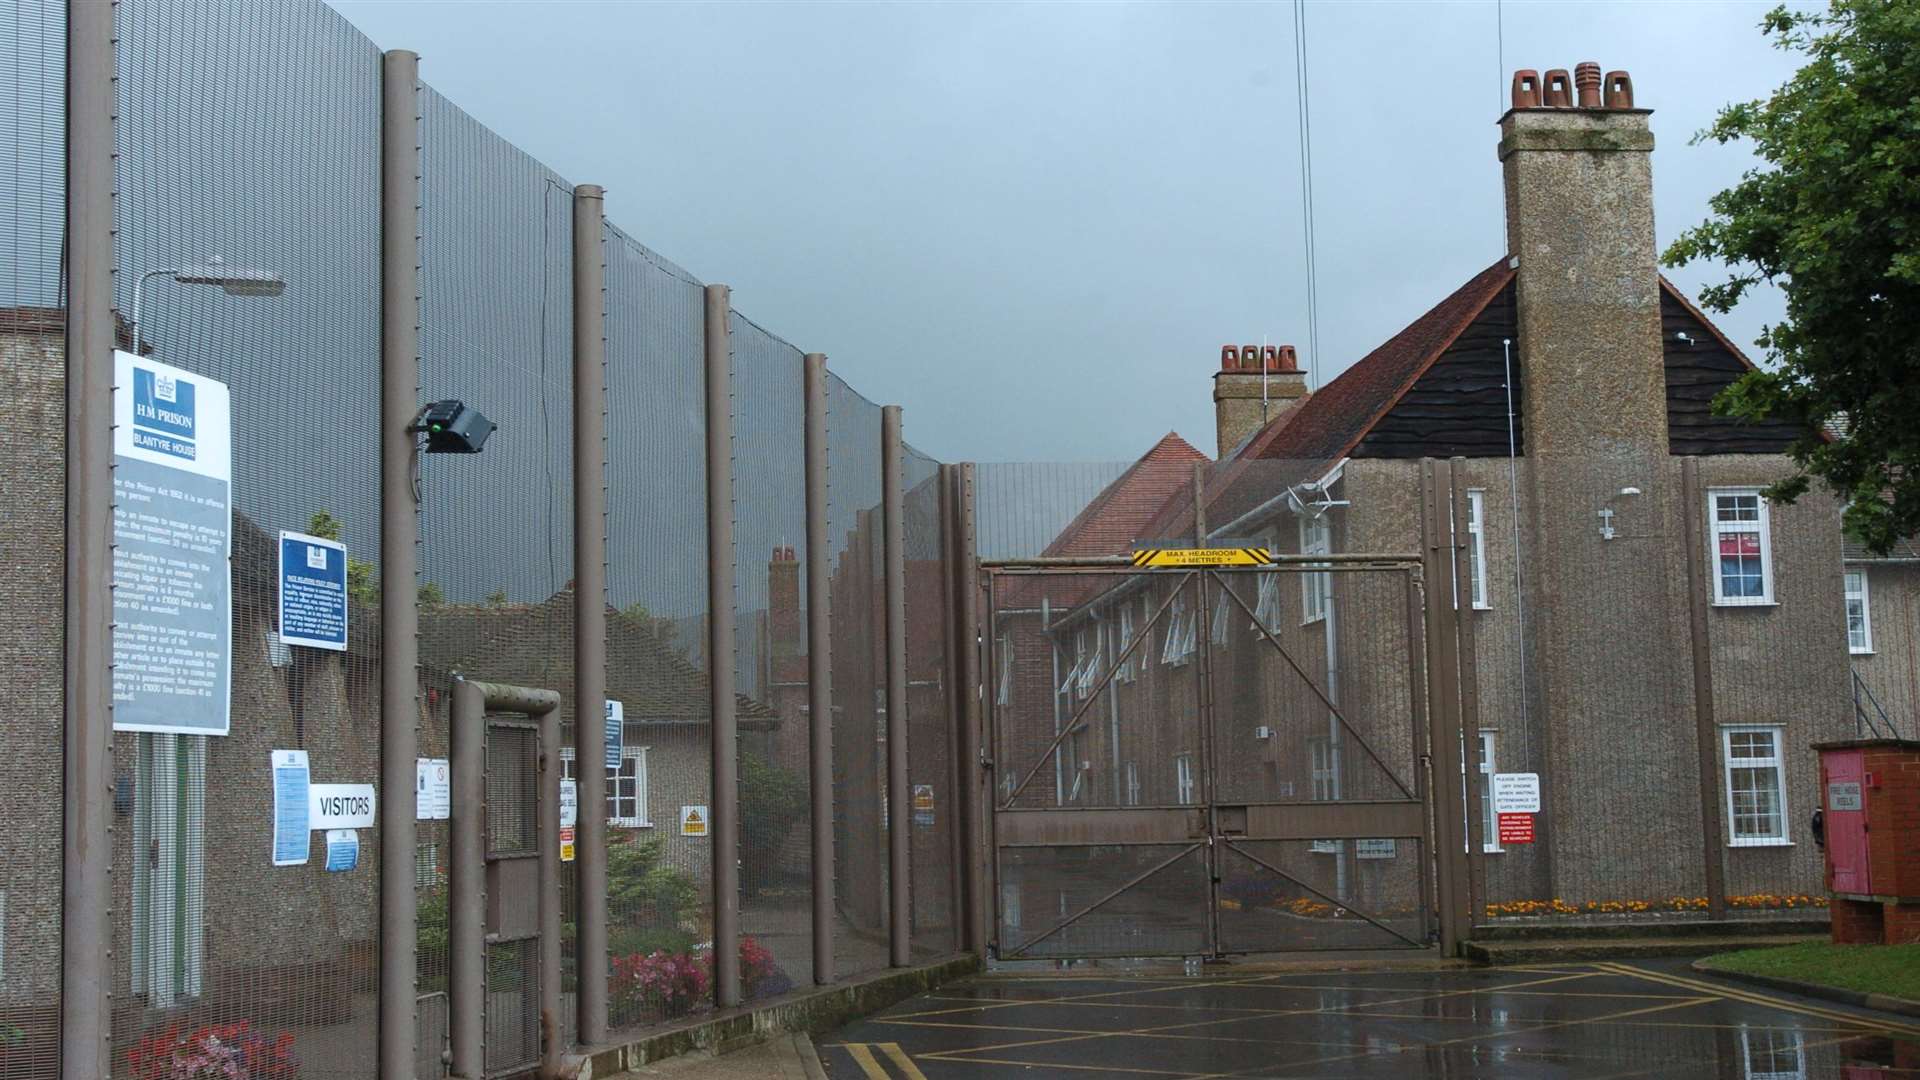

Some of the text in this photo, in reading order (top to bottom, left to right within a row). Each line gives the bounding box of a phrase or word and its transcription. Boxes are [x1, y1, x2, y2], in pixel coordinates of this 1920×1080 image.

[158, 408, 192, 428] PRISON
[134, 433, 196, 456] BLANTYRE HOUSE
[137, 482, 156, 493] Prison
[158, 487, 168, 496] Act
[320, 797, 369, 816] VISITORS
